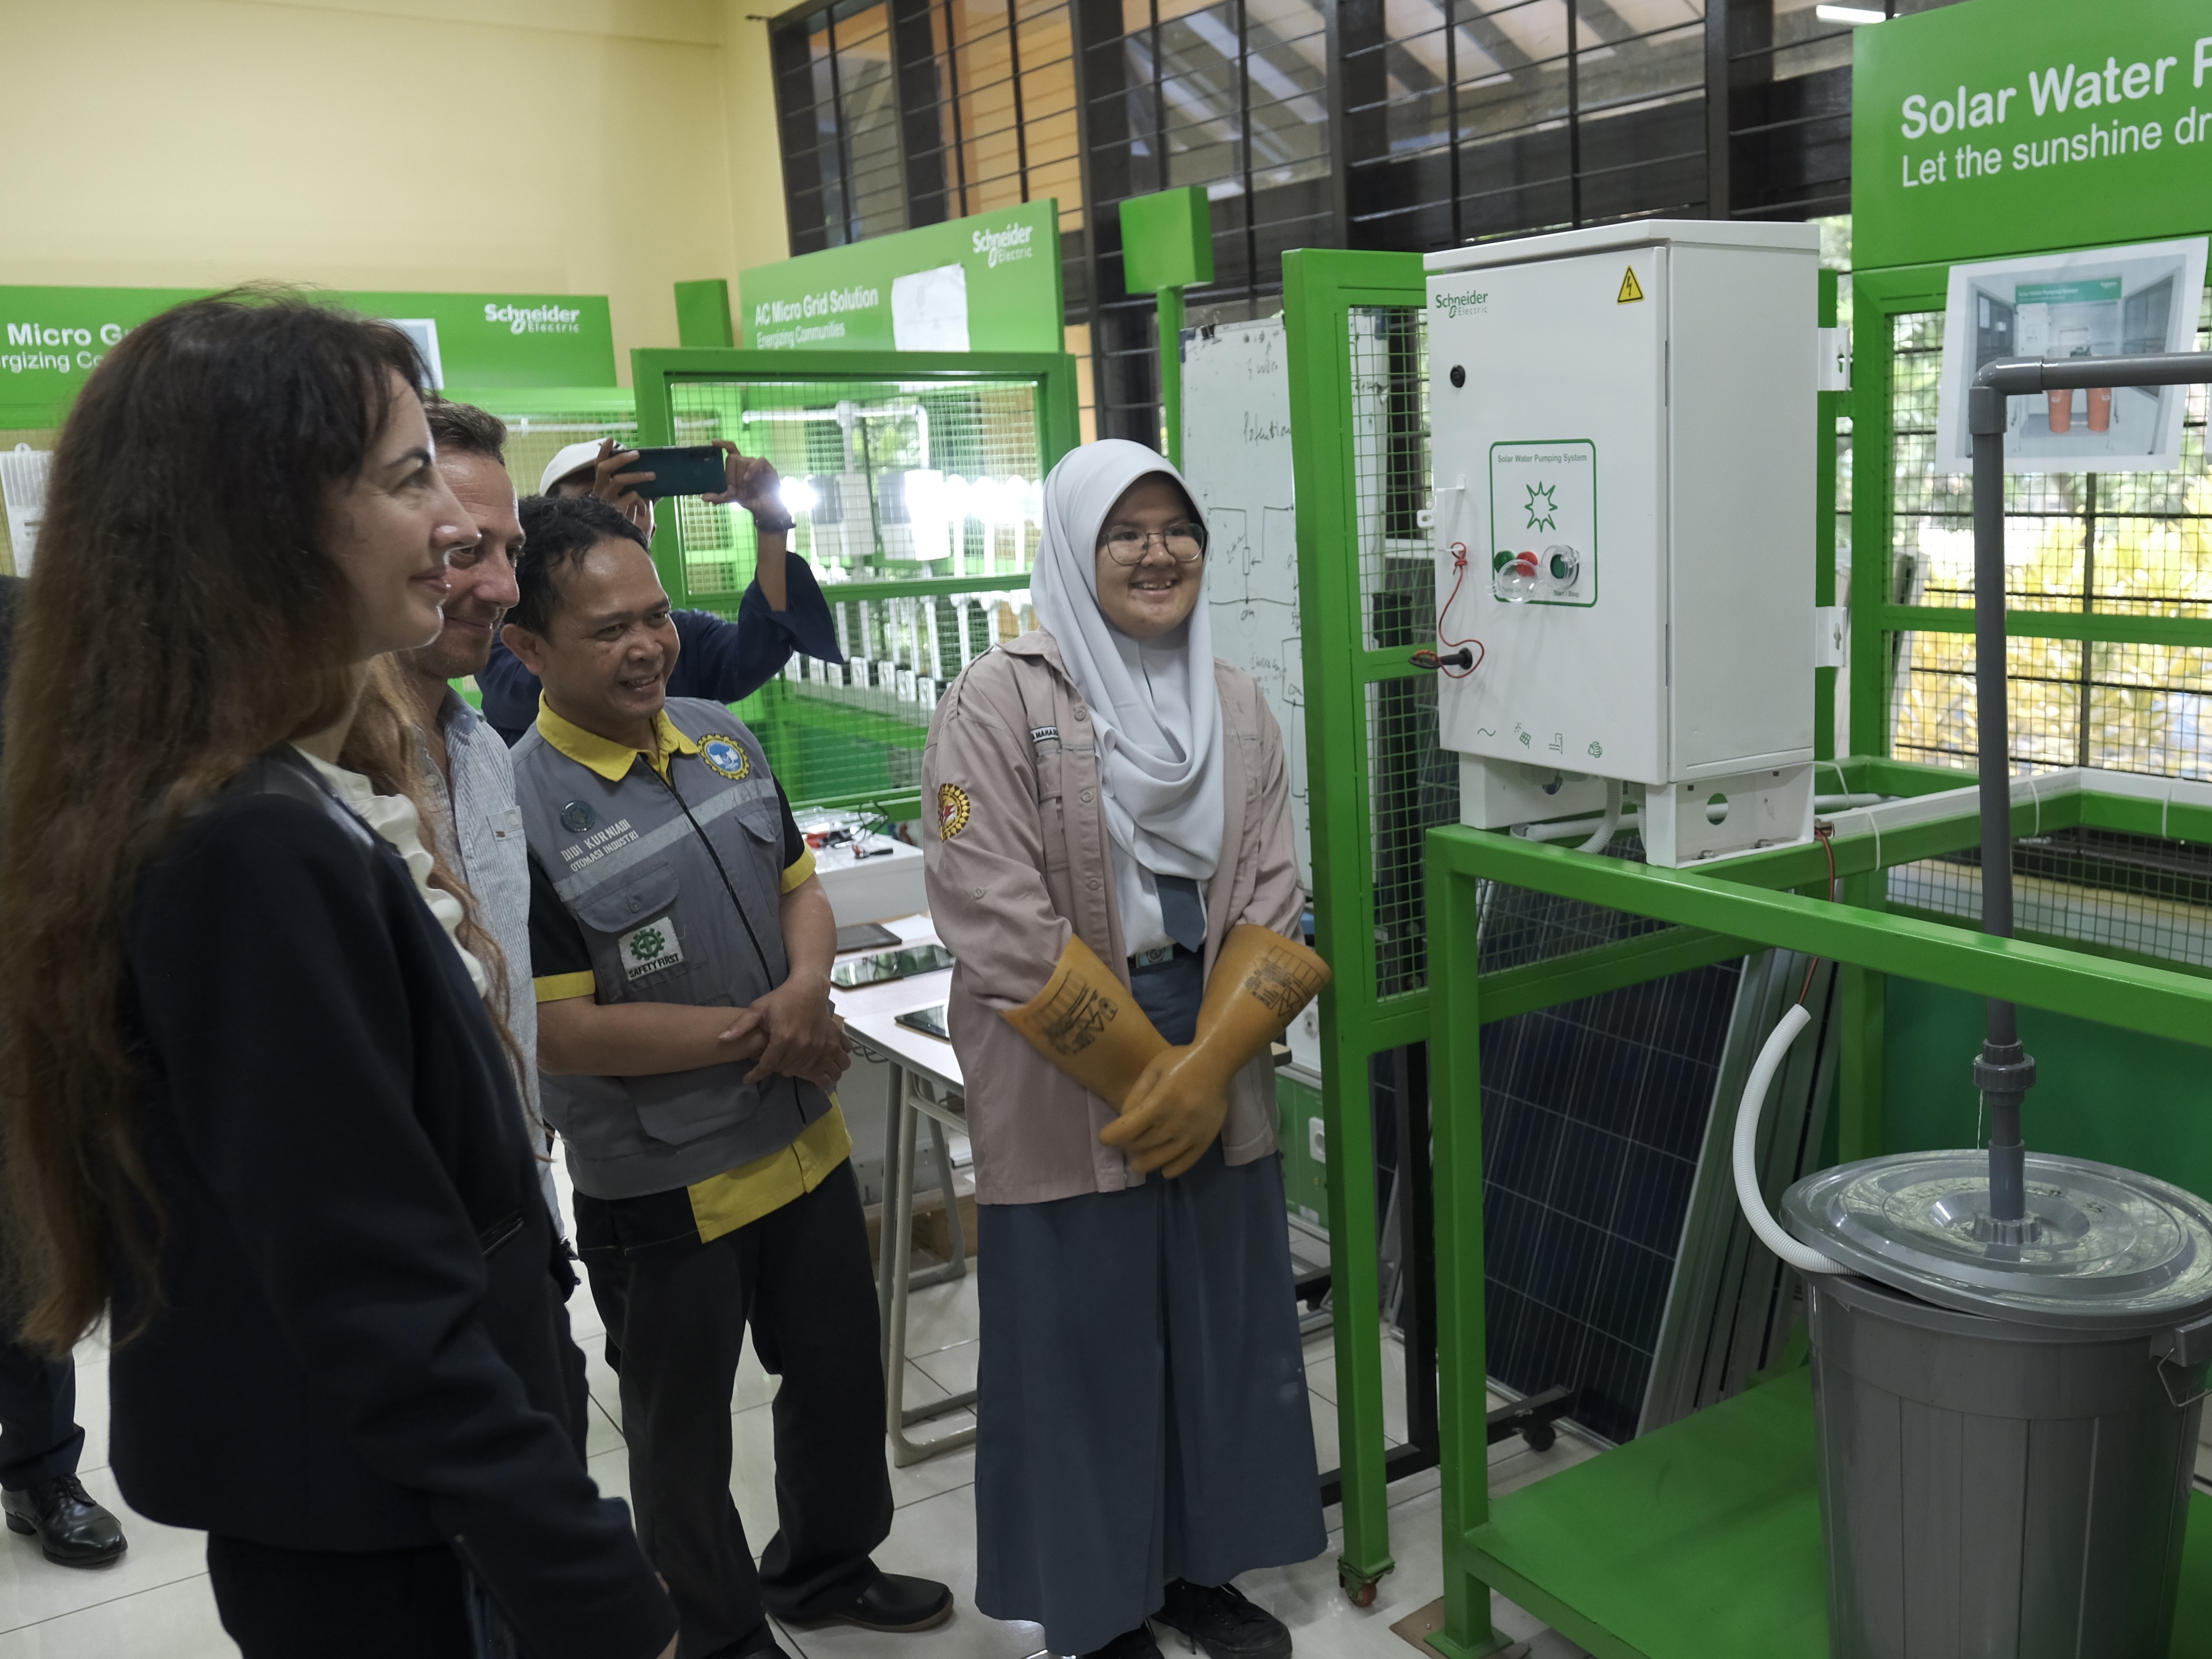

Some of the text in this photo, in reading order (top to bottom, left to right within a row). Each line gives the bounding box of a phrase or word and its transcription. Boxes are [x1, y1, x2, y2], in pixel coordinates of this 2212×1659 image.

[1901, 86, 2017, 140] Solar
[2028, 56, 2178, 117] Water
[1902, 106, 2212, 187] Let the sunshine dr
[973, 222, 1033, 254] Schneider
[755, 285, 879, 327] AC Micro Grid Solution
[1436, 289, 1488, 309] Schneider
[1458, 305, 1488, 316] Electric
[484, 303, 581, 323] Schneider
[7, 322, 92, 346] Micro
[528, 322, 580, 334] Electric
[0, 350, 70, 373] rgizing
[1534, 454, 1562, 463] Pumping
[1563, 453, 1587, 463] System
[560, 818, 632, 862] DIDI KURNIADI
[570, 830, 639, 872] OTOMASI INDUSTRI
[629, 953, 679, 978] SAFETY FIRST
